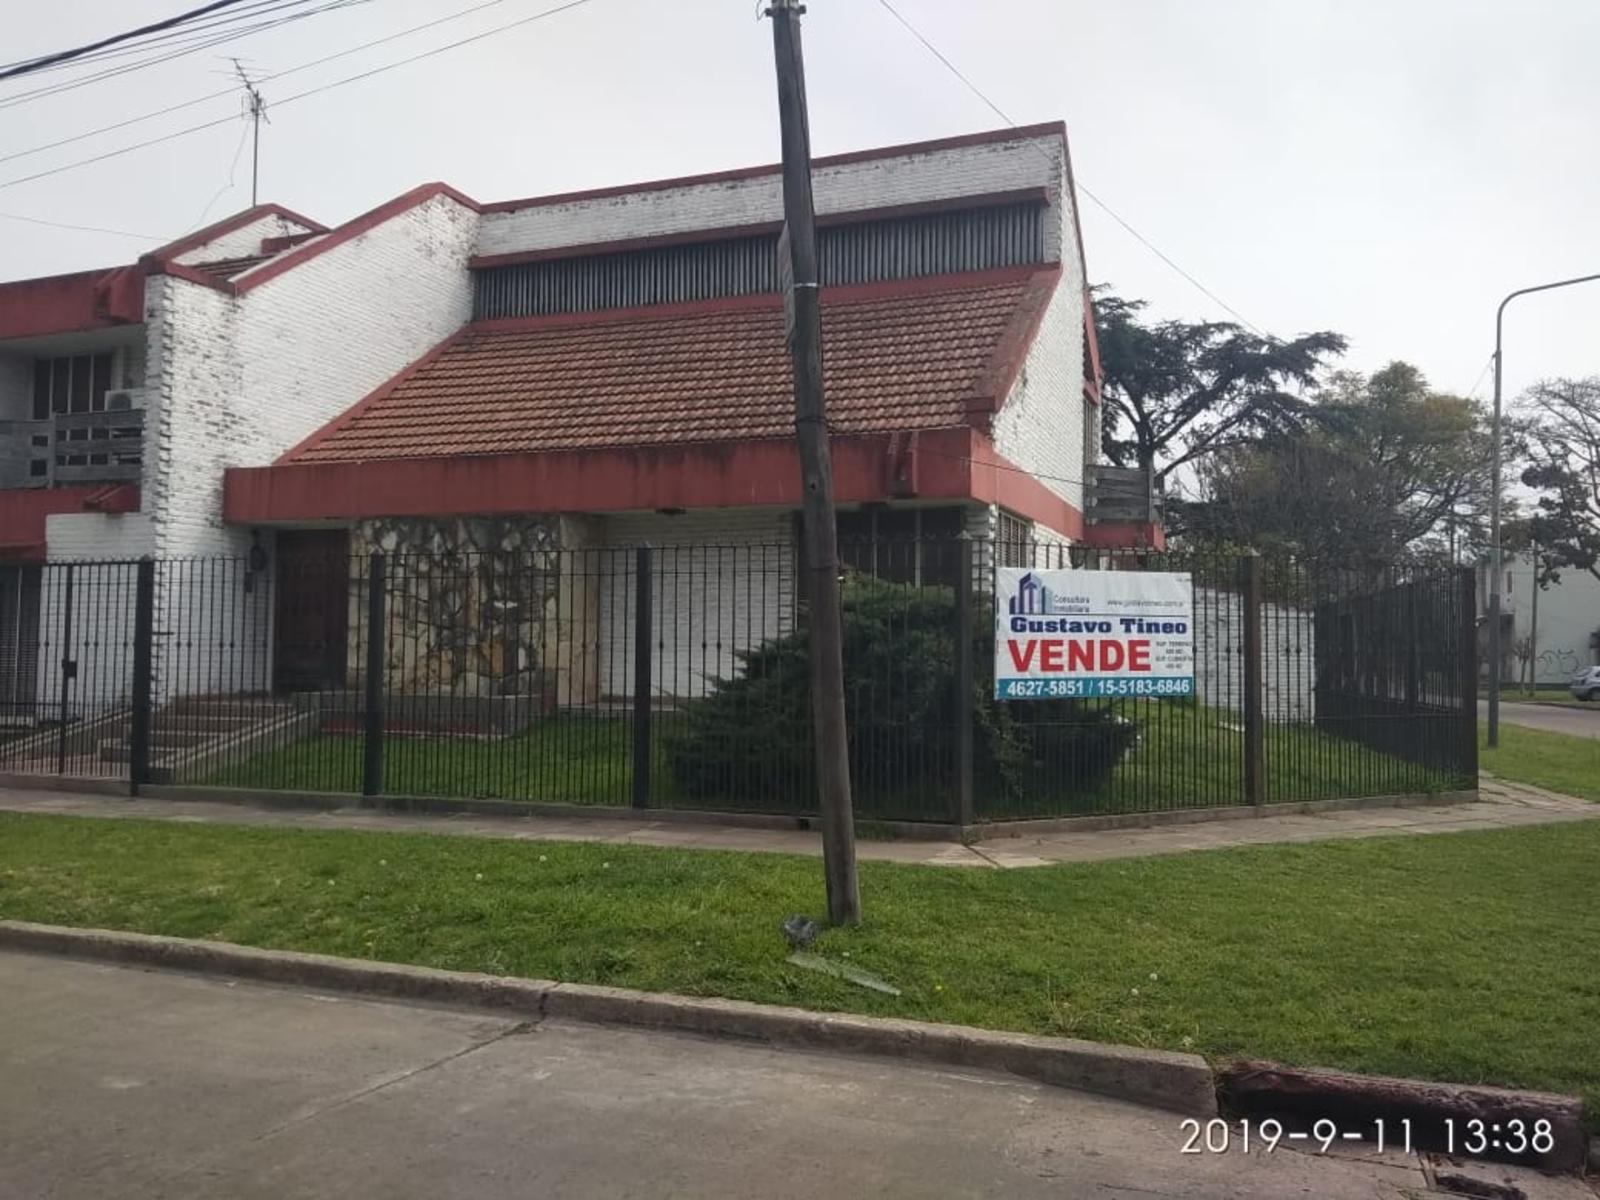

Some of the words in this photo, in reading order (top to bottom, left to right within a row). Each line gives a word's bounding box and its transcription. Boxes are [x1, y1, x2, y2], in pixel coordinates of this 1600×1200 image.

[1010, 616, 1112, 633] Gustavo
[1120, 618, 1187, 634] Tineo
[1007, 639, 1152, 673] VENDE
[1007, 681, 1084, 696] 4627-5851
[1098, 679, 1190, 695] 15-5183-6846
